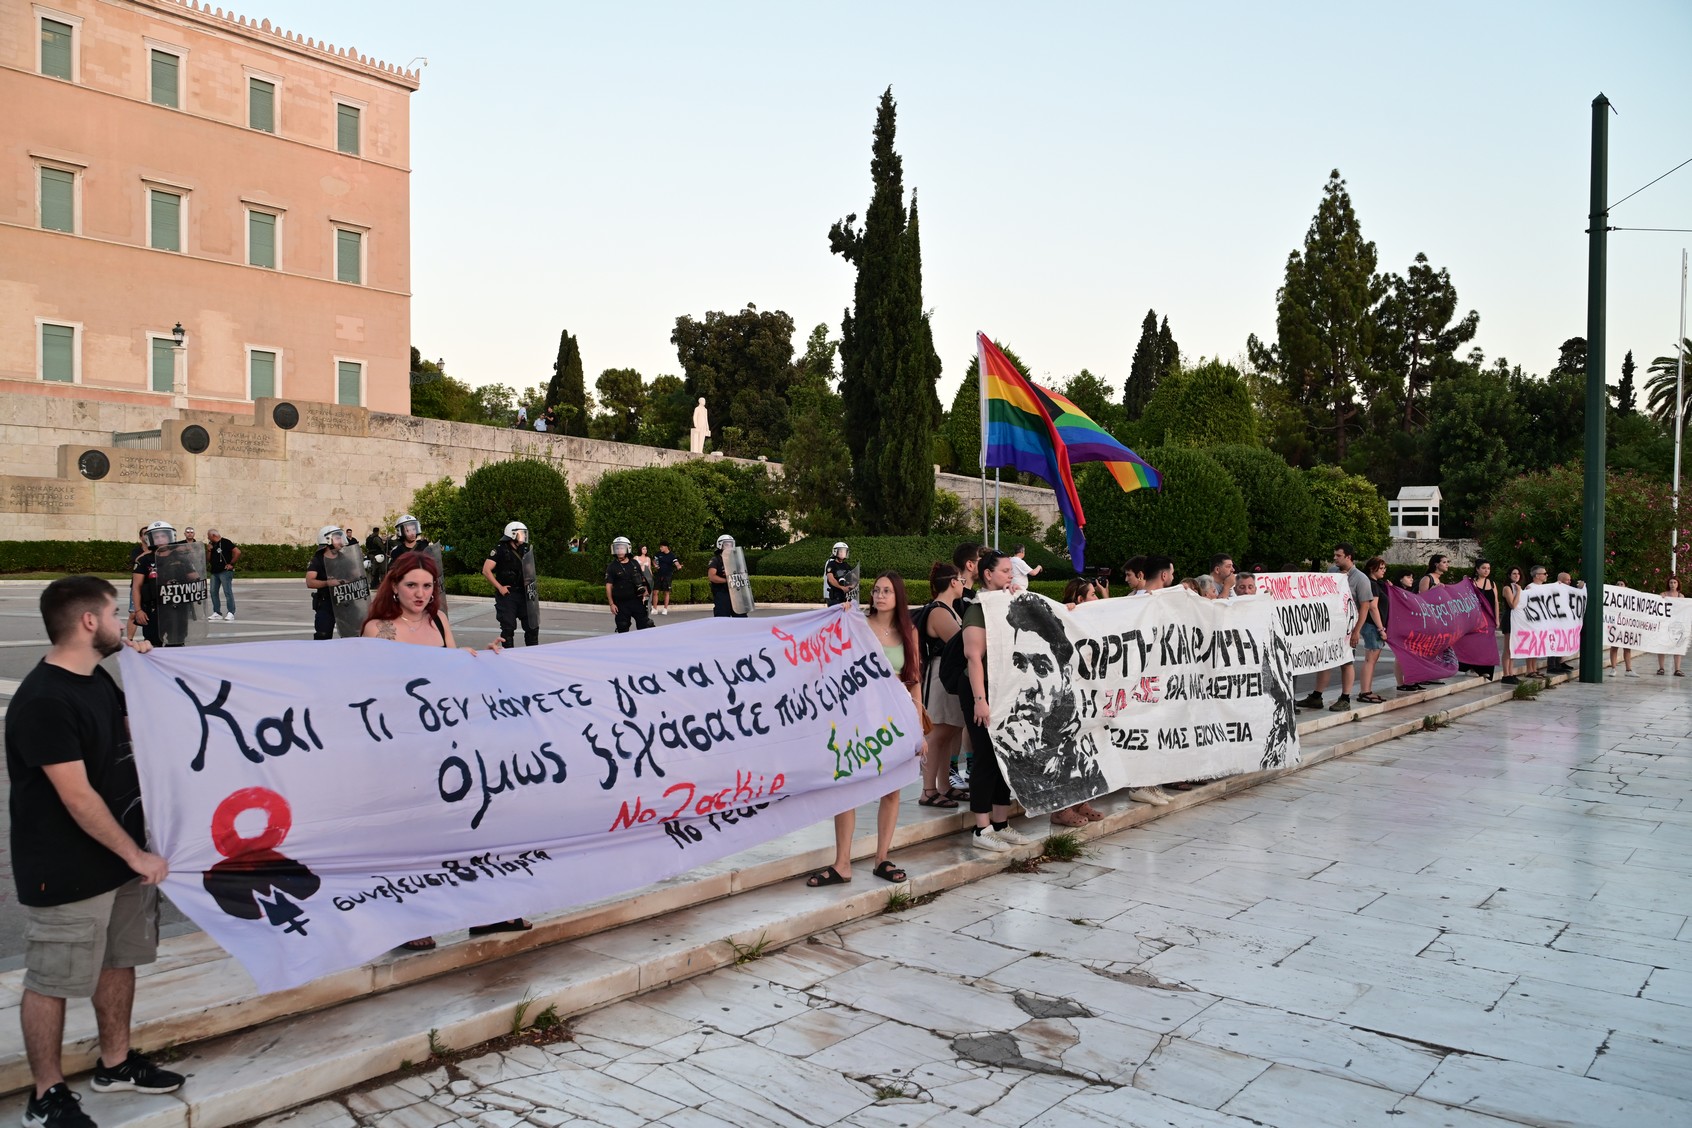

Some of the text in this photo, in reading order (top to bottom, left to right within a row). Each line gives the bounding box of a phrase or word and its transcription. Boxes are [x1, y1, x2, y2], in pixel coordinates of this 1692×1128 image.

[162, 590, 206, 605] POLICE
[336, 588, 369, 604] POLICE
[1603, 591, 1673, 618] ZACKIE NO PEACE
[1514, 630, 1548, 656] ZAK
[175, 677, 323, 772] Και
[405, 677, 469, 732] δεν
[482, 684, 592, 721] κάνετε
[607, 672, 666, 719] για
[667, 662, 714, 688] να
[714, 647, 776, 705] μας
[1080, 689, 1098, 718] Η
[827, 715, 905, 781] Σπόροι
[1080, 732, 1099, 758] ΟΙ
[1157, 728, 1190, 750] ΜΑΣ
[1225, 722, 1253, 742] ΞΙΑ
[438, 740, 567, 830] όμως
[582, 701, 770, 790] ξεχάσατε
[774, 683, 817, 726] πώς
[608, 796, 657, 832] No
[441, 860, 478, 882] 8
